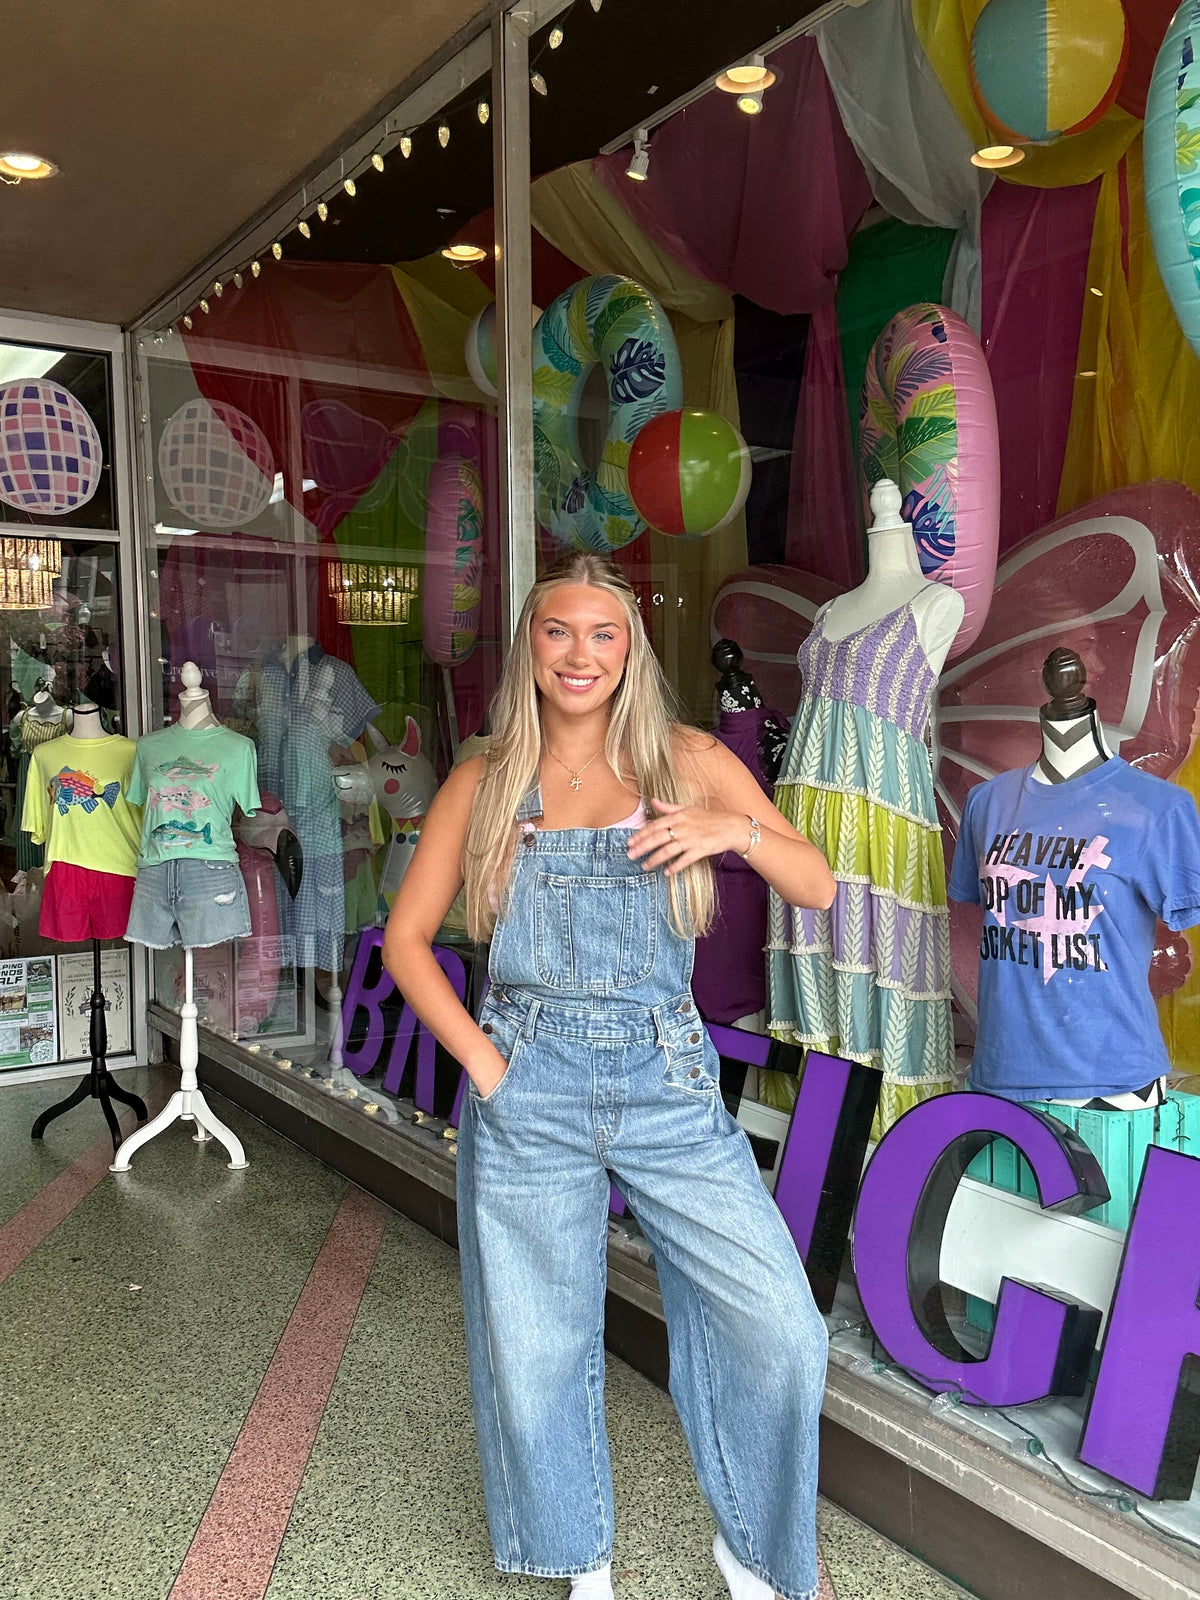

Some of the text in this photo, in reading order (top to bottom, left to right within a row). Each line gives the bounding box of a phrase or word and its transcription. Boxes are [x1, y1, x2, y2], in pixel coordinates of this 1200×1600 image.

[985, 832, 1087, 870] HEAVEN.
[1016, 879, 1046, 914] OF
[1055, 882, 1095, 920] MY
[980, 925, 1109, 972] UCKET LIST.
